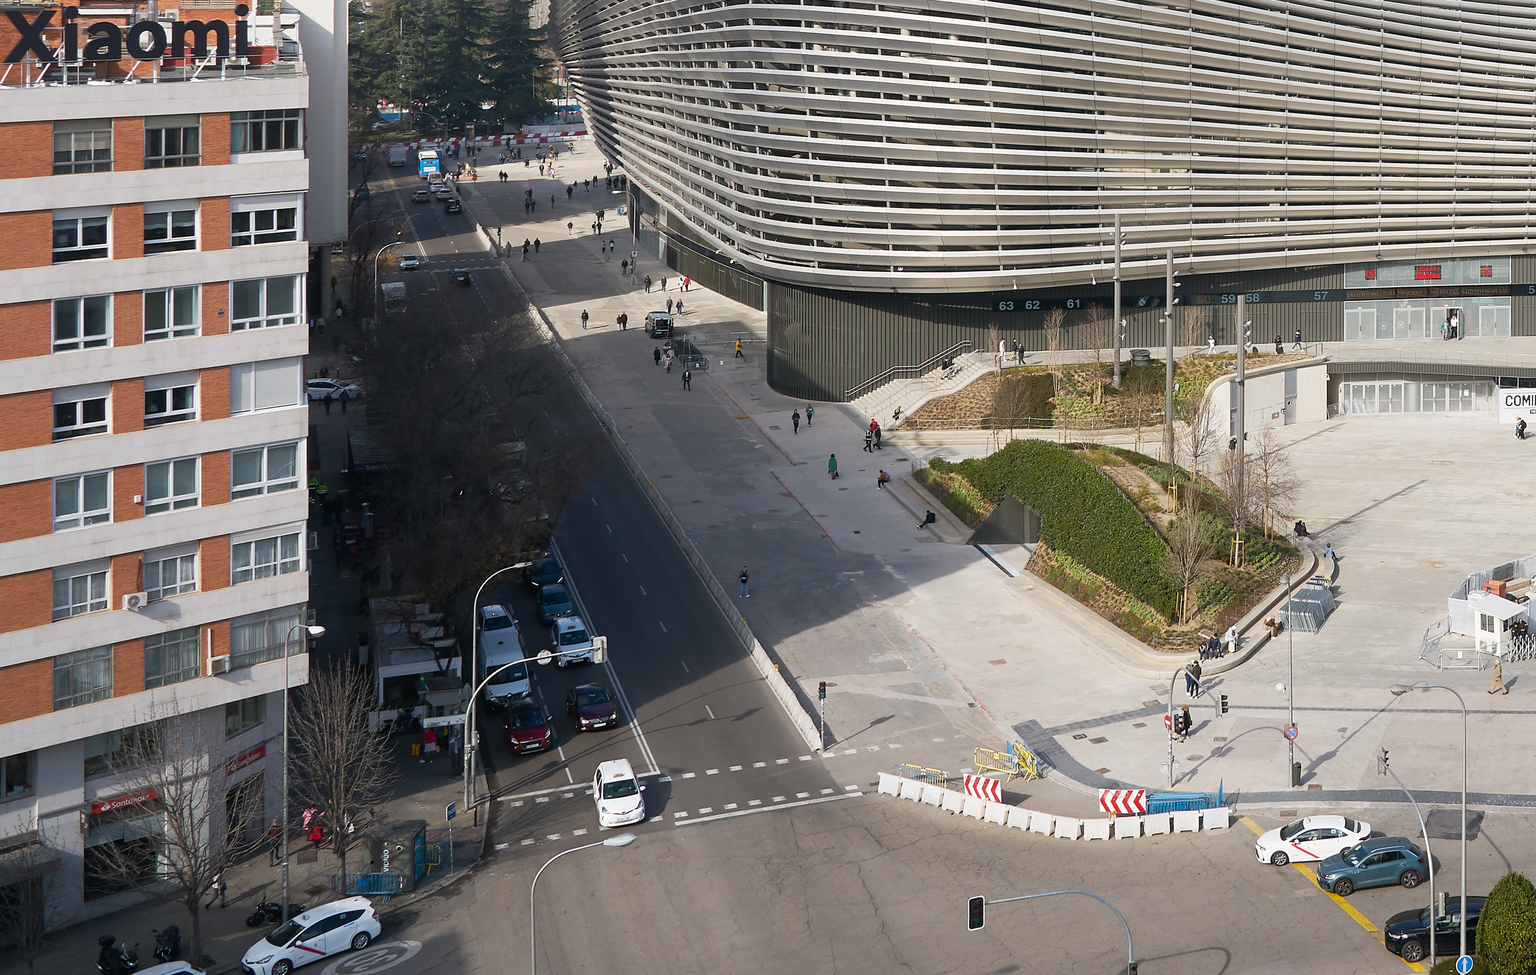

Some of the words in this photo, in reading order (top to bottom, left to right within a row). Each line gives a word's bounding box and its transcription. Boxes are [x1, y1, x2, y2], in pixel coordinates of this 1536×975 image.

[4, 4, 249, 63] Xiaomi
[1197, 295, 1211, 304] 60
[1221, 294, 1236, 303] 59
[1245, 293, 1260, 302] 58
[1314, 291, 1328, 300] 57
[999, 301, 1014, 311] 63
[1025, 300, 1040, 310] 62
[1067, 299, 1080, 309] 61
